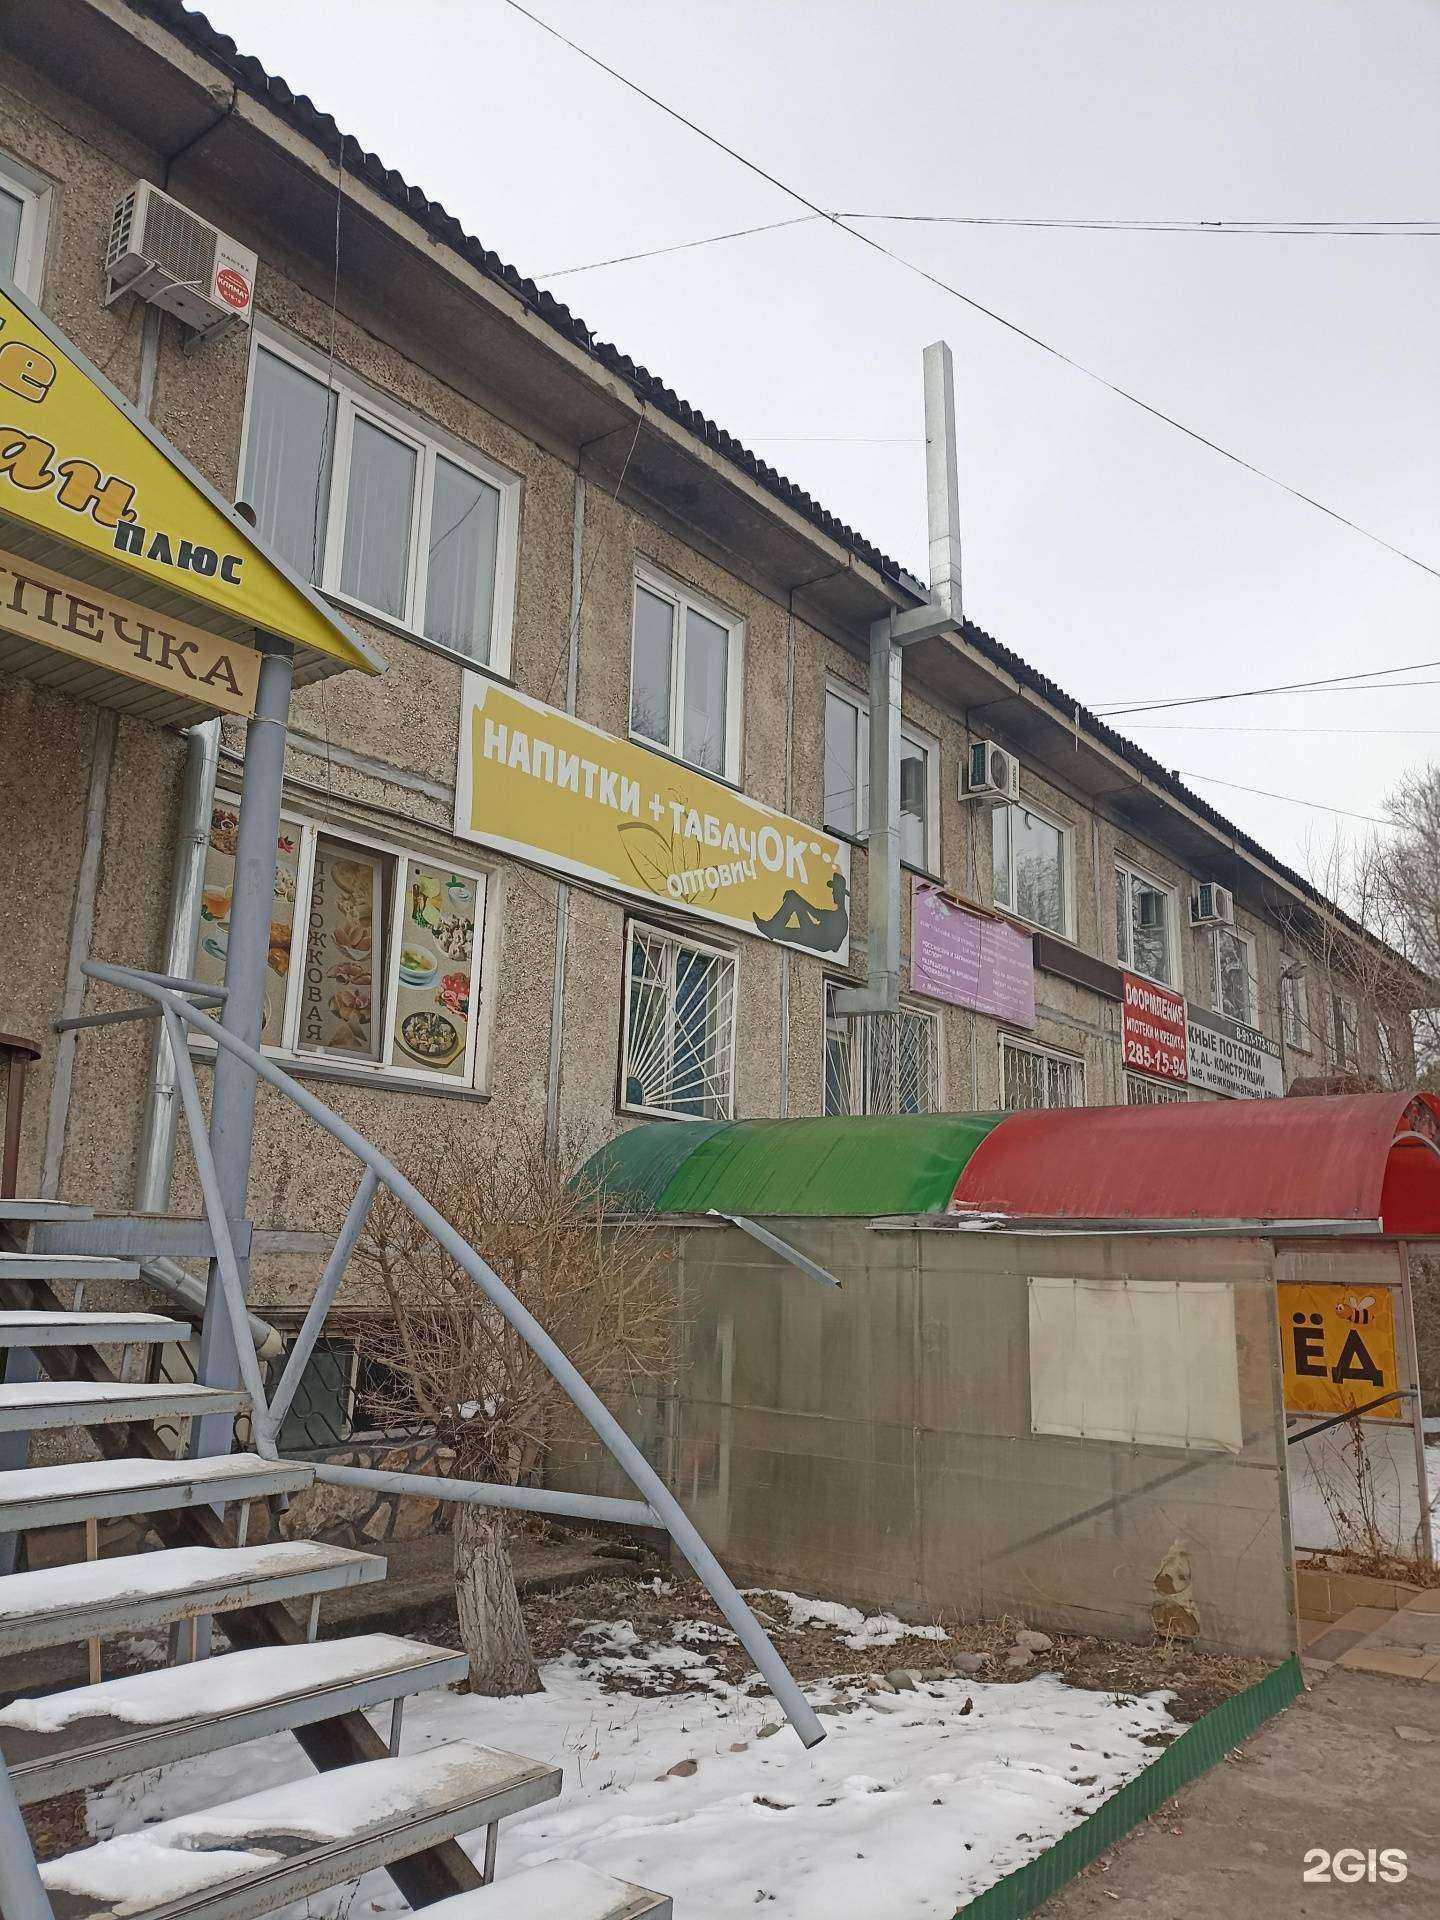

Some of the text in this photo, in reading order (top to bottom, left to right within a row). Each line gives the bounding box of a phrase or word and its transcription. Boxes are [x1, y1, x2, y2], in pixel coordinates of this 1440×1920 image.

[113, 520, 244, 585] ПЛЮС
[0, 566, 244, 697] ПЕЧКА
[483, 717, 641, 819] НАПИТКИ
[668, 801, 810, 885] ТАБАЧОК
[666, 858, 758, 898] ОПТОВИЧ
[305, 859, 327, 1042] ПИРОЖКОВАЯ
[1125, 982, 1184, 1026] ОФОРМЛЕНИЕ
[1127, 1040, 1187, 1079] 285-15-94
[1214, 1056, 1266, 1087] КОНСТРУКЦИИ
[1220, 1038, 1262, 1070] ПОТОЛКИ
[1280, 1312, 1384, 1387] ЁД
